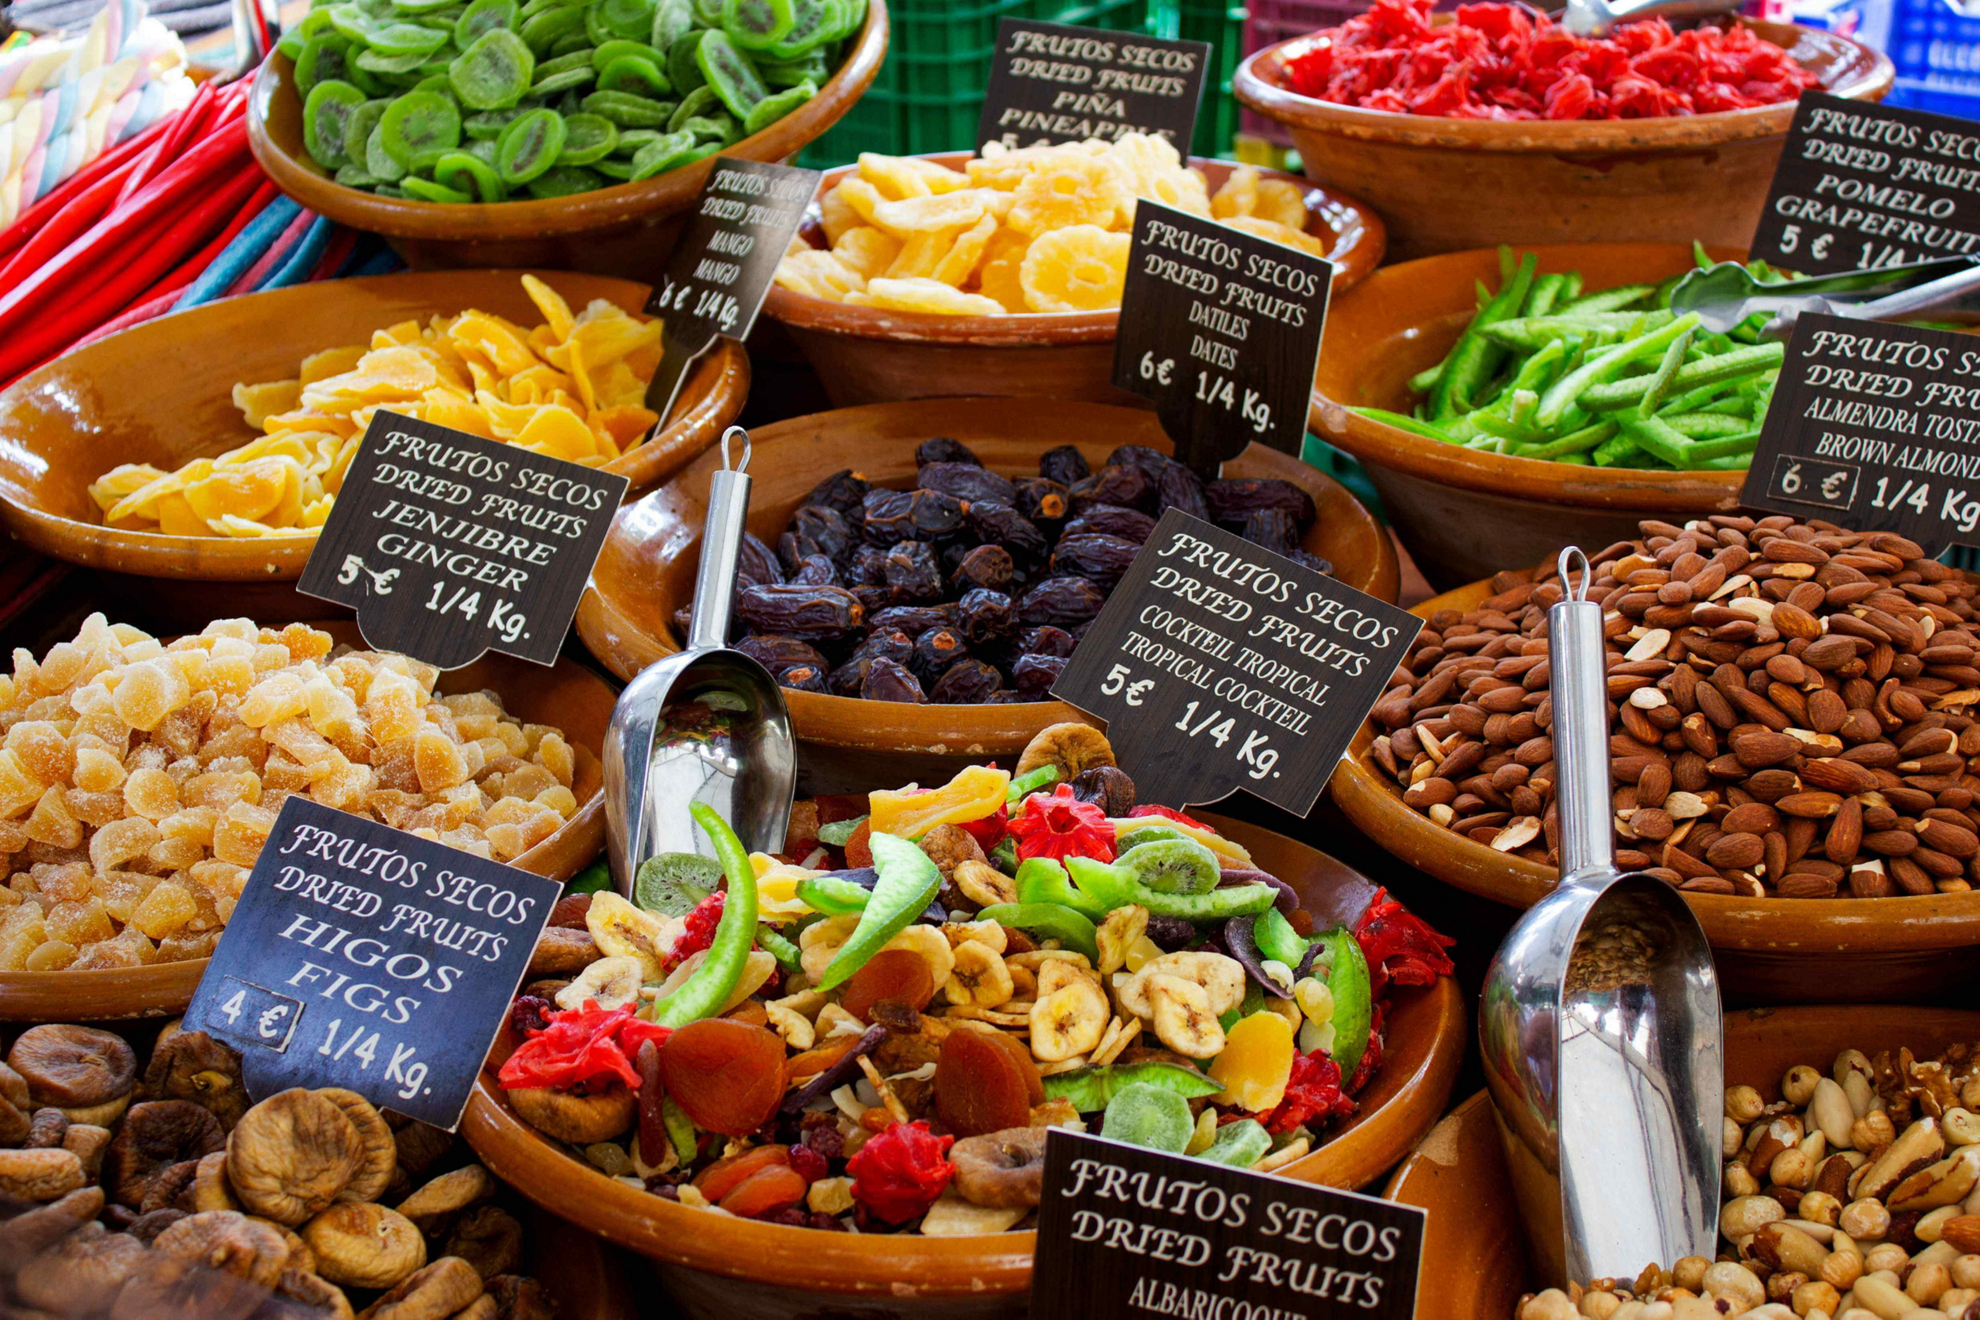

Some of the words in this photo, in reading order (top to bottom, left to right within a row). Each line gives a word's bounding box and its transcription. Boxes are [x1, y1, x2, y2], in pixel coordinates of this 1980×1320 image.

[1006, 31, 1117, 62] FRUTOS
[1117, 45, 1198, 73] SECOS
[1008, 57, 1093, 85] DRIED
[1092, 69, 1187, 97] FRUITS
[1052, 91, 1126, 119] PIÑA
[1802, 108, 1922, 148] FRUTOS
[707, 169, 770, 196] FRUTOS
[1802, 138, 1891, 173] DRIED
[1890, 157, 1980, 195] FRUIT
[1814, 173, 1956, 219] POMELO
[700, 196, 746, 220] DRIED
[1775, 195, 1980, 254] GRAPEFRUIT
[706, 230, 754, 257] MANGO
[1141, 220, 1242, 271] FRUTOS
[1244, 254, 1319, 298] SECOS
[1779, 224, 1802, 254] 5
[1811, 233, 1834, 260] €
[693, 258, 741, 286] MANGO
[1144, 254, 1219, 296] DRIED
[1219, 282, 1308, 328] FRUITS
[1188, 300, 1250, 341] DATILES
[1190, 335, 1239, 371] DATES
[1802, 330, 1950, 371] FRUTOS
[1195, 371, 1236, 411] 1/4
[1241, 388, 1276, 433] Kg.
[1804, 364, 1913, 399] DRIED
[1803, 396, 1919, 435] ALMENDRA
[374, 430, 510, 483] FRUTOS
[510, 467, 609, 511] SECOS
[1814, 431, 1897, 465] BROWN
[372, 462, 473, 506] DRIED
[471, 493, 588, 540] FRUITS
[1781, 463, 1802, 494] 6
[1821, 471, 1848, 499] €
[1871, 476, 1930, 515] 1/4
[372, 499, 558, 567] JENJIBRE
[377, 533, 529, 592] GINGER
[426, 580, 482, 621] 1/4
[487, 599, 531, 643] Kg.
[1157, 532, 1299, 603] FRUTOS
[1295, 591, 1399, 650] SECOS
[1150, 566, 1253, 623] DRIED
[1248, 613, 1371, 678] FRUITS
[1120, 631, 1215, 690] TROPICAL
[1213, 676, 1312, 737] COCKTEIL
[1139, 604, 1235, 662] COCKTEIL
[1231, 647, 1328, 707] TROPICAL
[1175, 700, 1237, 748] 1/4
[1236, 729, 1281, 780] Kg.
[280, 824, 427, 889] FRUTOS
[425, 869, 537, 926] SECOS
[274, 865, 383, 918] DRIED
[380, 903, 509, 963] FRUITS
[278, 913, 464, 994] HIGOS
[285, 960, 422, 1024] FIGS
[221, 989, 247, 1026] 4
[317, 1018, 381, 1070] 1/4
[384, 1042, 432, 1101] Kg.
[1061, 1158, 1252, 1229] FRUTOS
[1259, 1201, 1401, 1263] SECOS
[1071, 1209, 1211, 1268] DRIED
[1218, 1245, 1385, 1310] FRUITS
